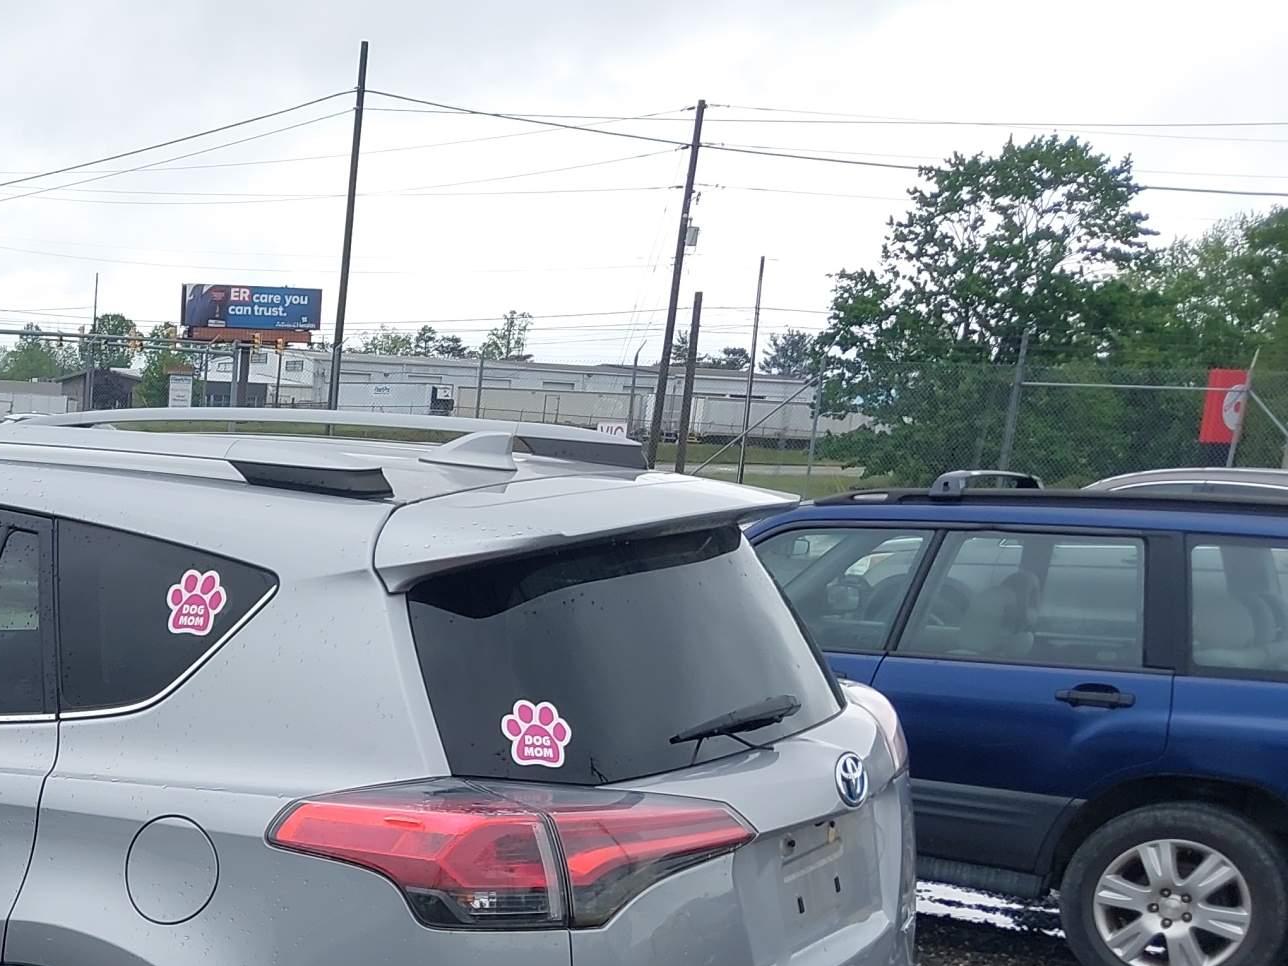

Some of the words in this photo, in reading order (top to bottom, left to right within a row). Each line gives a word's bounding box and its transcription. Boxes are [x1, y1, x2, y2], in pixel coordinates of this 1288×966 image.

[230, 287, 250, 301] ER
[253, 293, 281, 303] care
[284, 295, 308, 307] you
[228, 305, 251, 315] can
[253, 305, 287, 317] trust.
[182, 604, 205, 615] DOG
[179, 616, 204, 626] MOM
[524, 735, 551, 746] DOG
[524, 747, 553, 758] MOM
